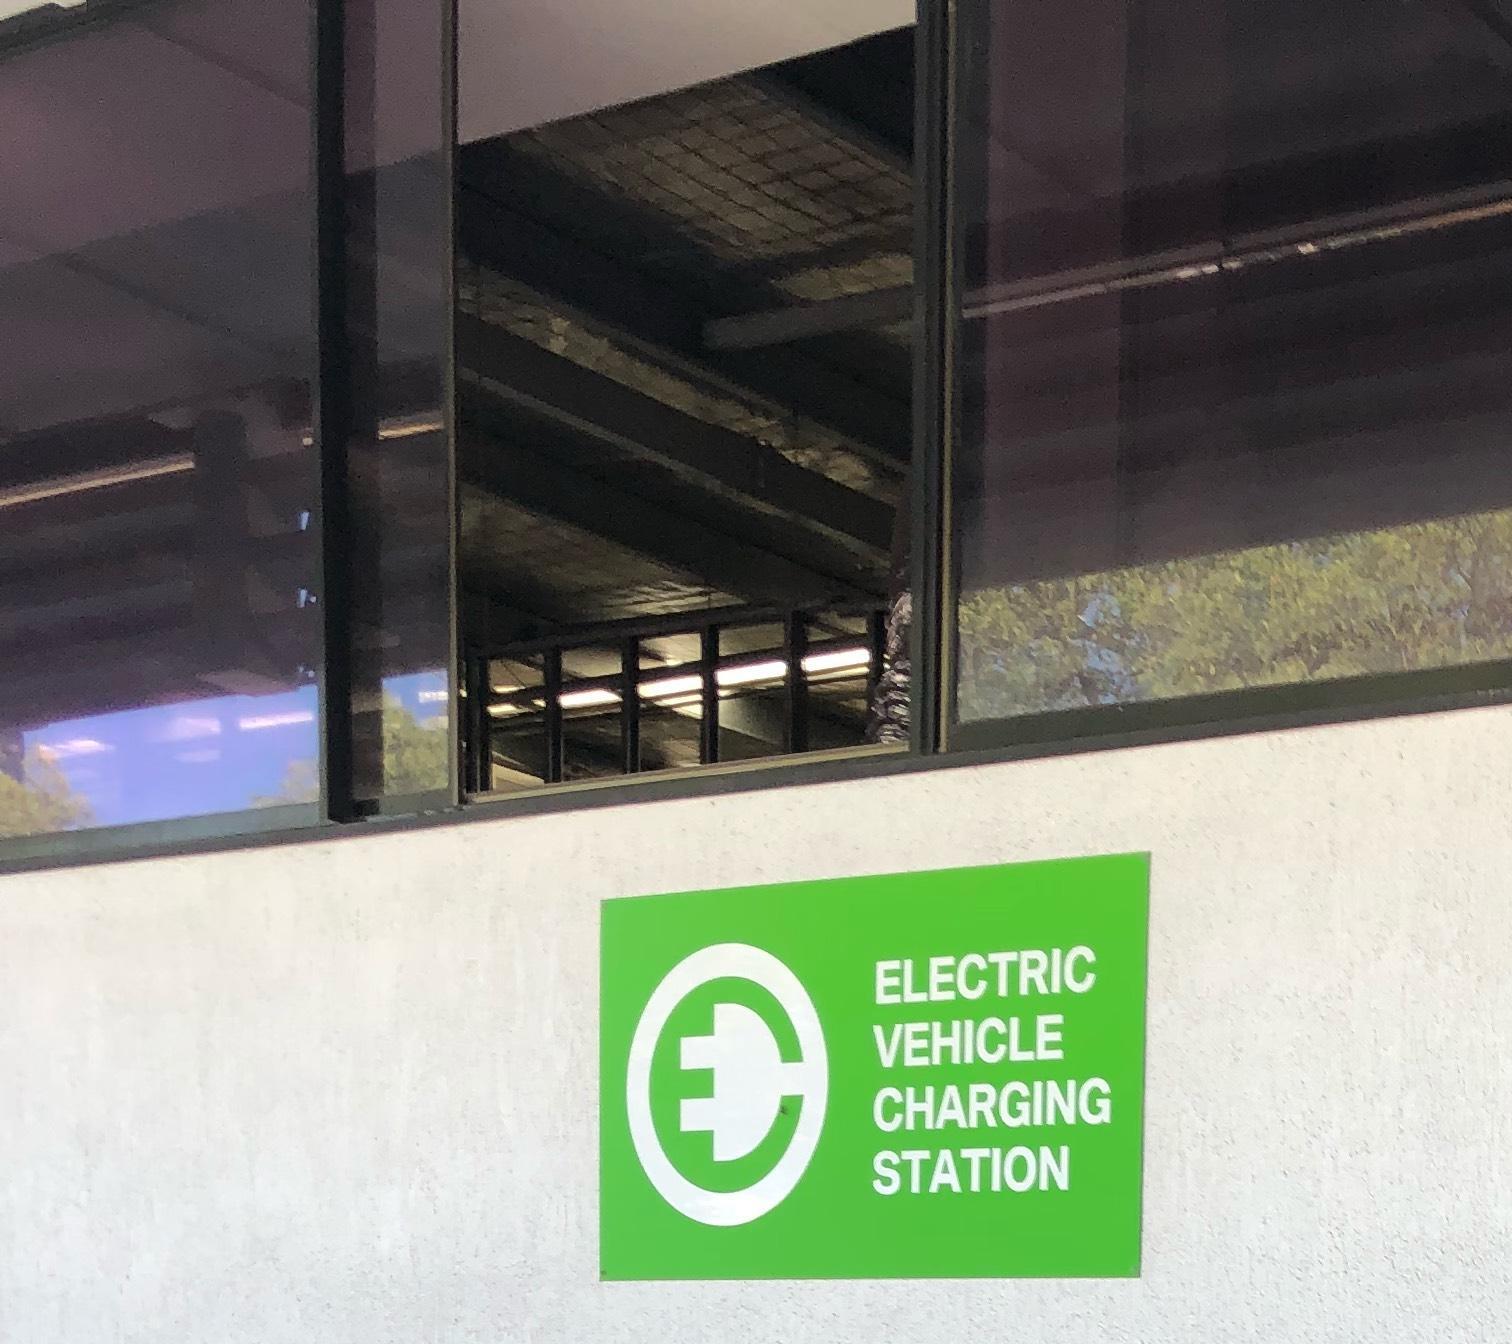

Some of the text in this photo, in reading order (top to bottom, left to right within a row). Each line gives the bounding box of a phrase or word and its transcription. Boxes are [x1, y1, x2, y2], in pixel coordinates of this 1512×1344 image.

[875, 945, 1096, 1004] ELECTRIC
[873, 1014, 1064, 1068] VEHICLE
[873, 1077, 1111, 1132] CHARGING
[872, 1145, 1070, 1196] STATION
